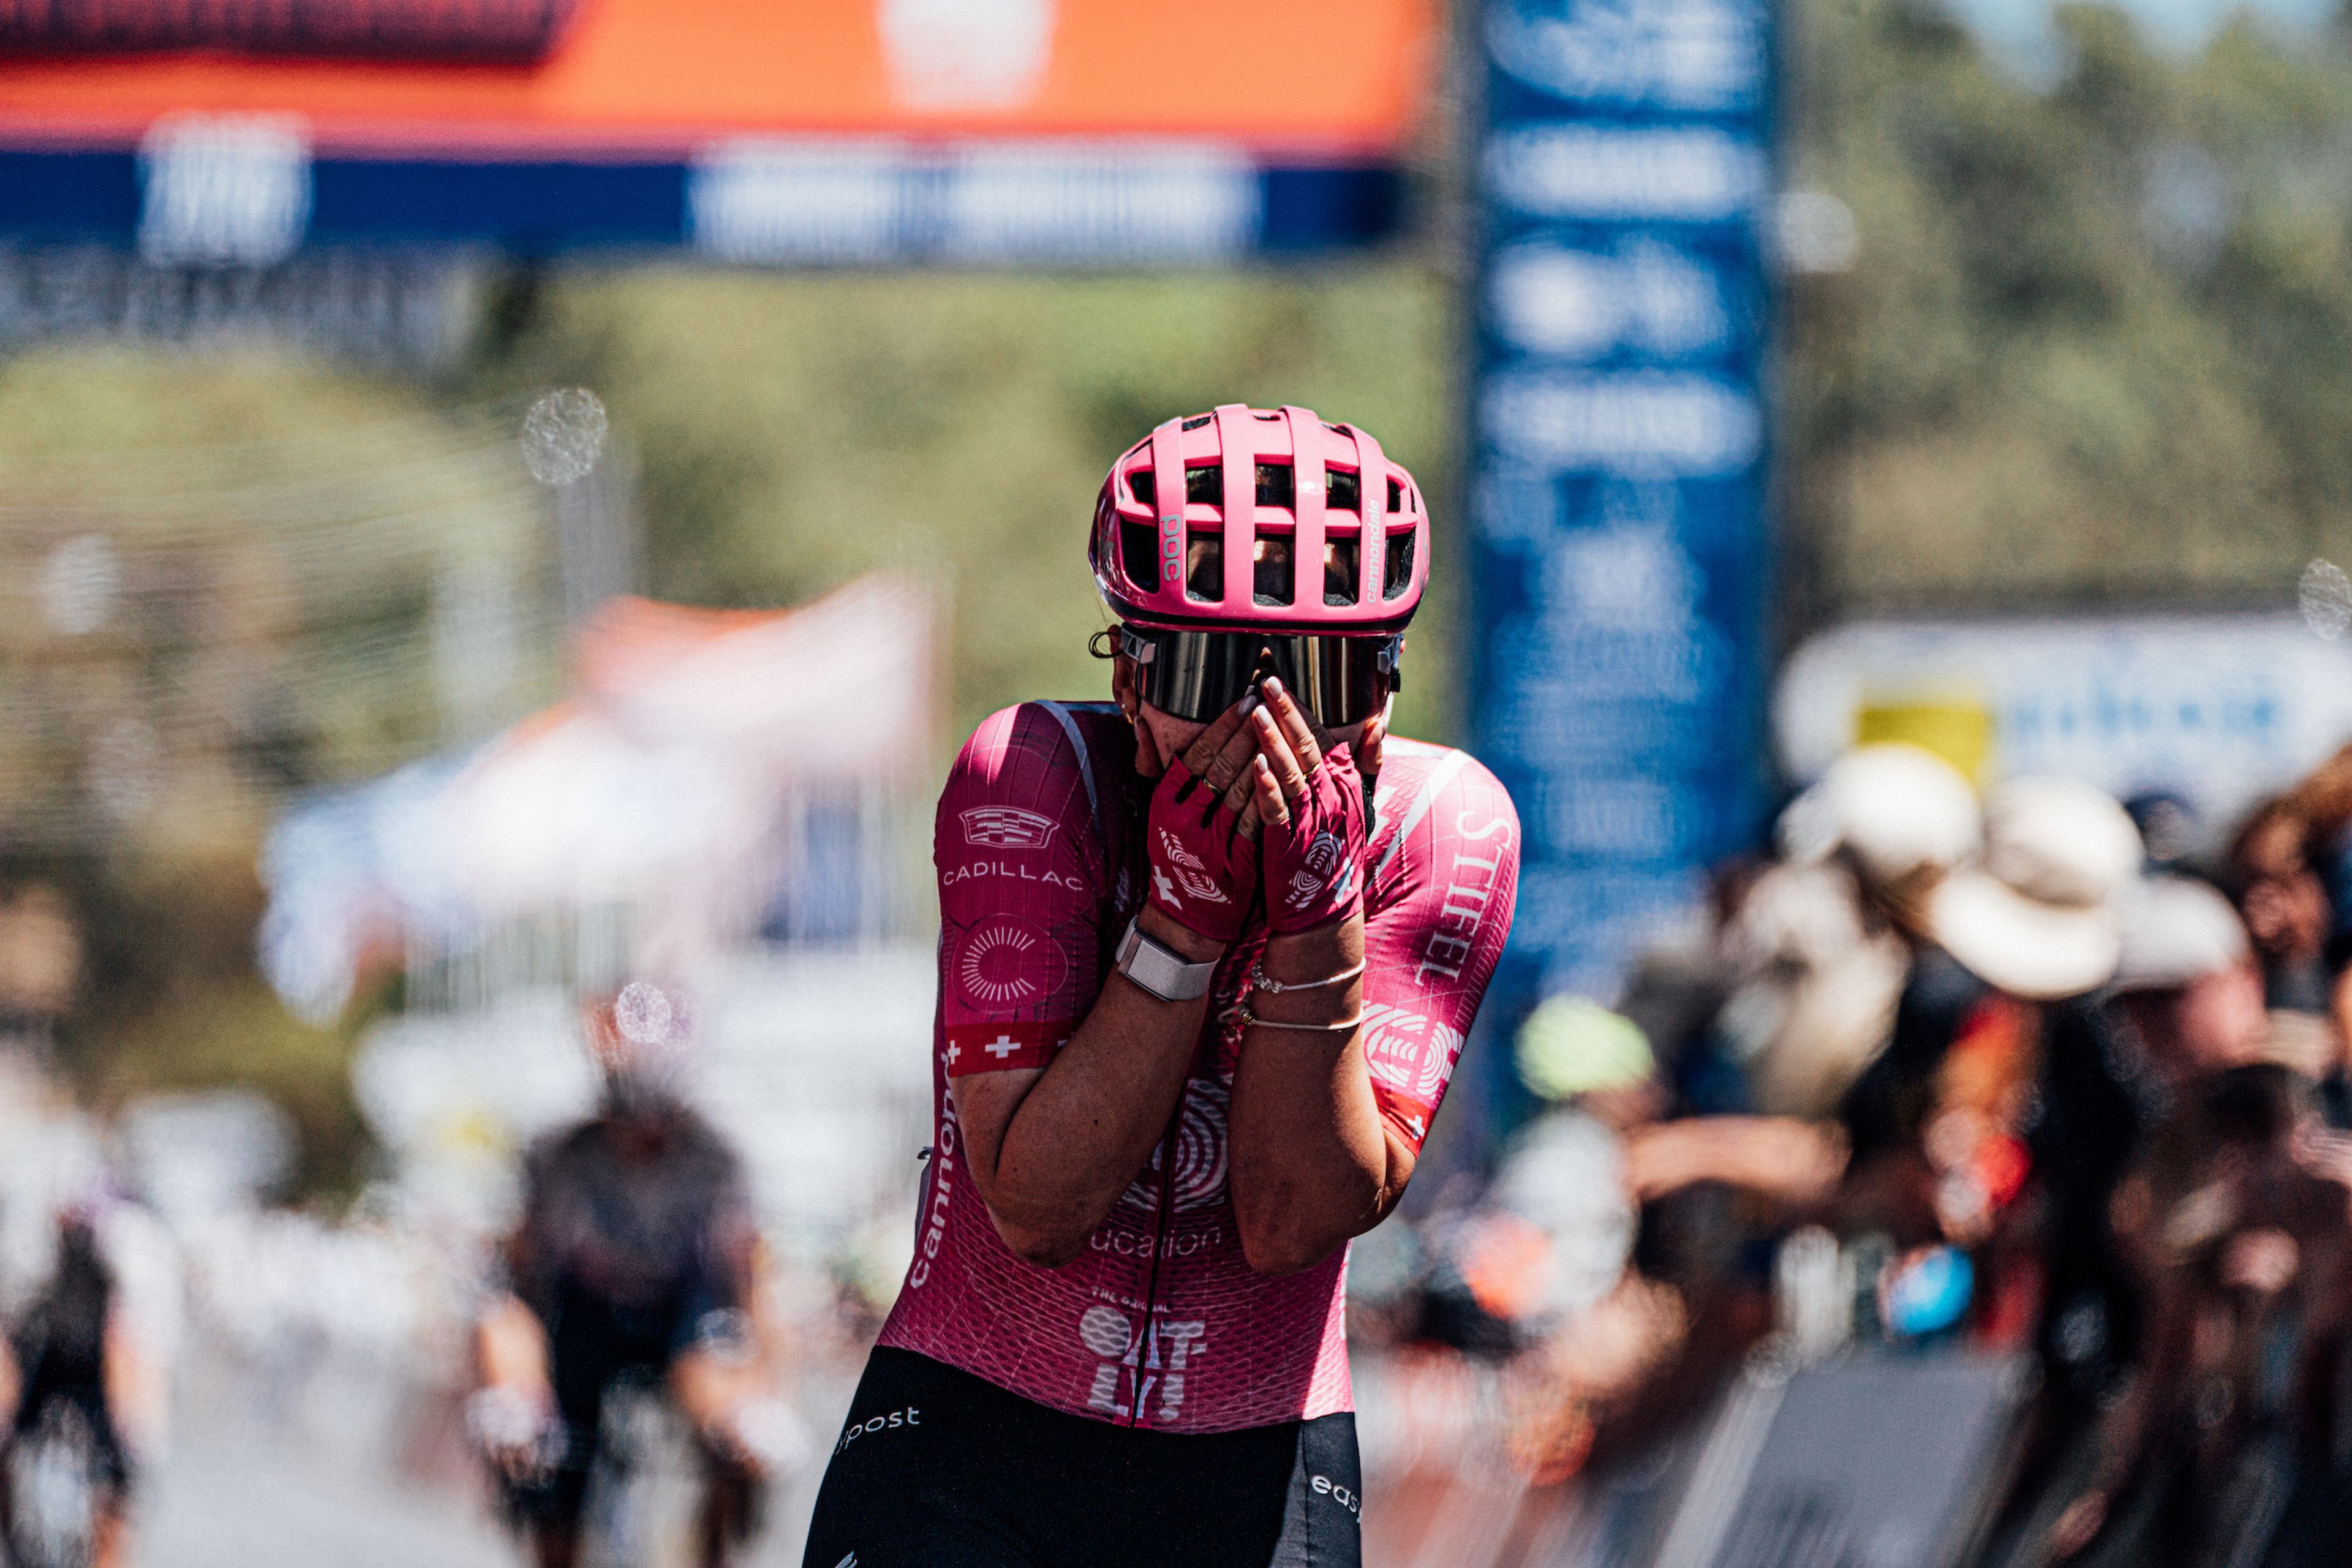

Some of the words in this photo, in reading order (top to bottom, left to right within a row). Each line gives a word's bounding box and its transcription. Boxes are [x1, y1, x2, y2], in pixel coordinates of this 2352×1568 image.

[1160, 514, 1181, 582] poc
[1366, 499, 1380, 604] cannondale
[943, 861, 1084, 891] CADILLAC
[1414, 810, 1512, 987] STIFEL
[1090, 1226, 1221, 1259] ucation
[1091, 1286, 1117, 1303] THE
[835, 1407, 920, 1455] ypost
